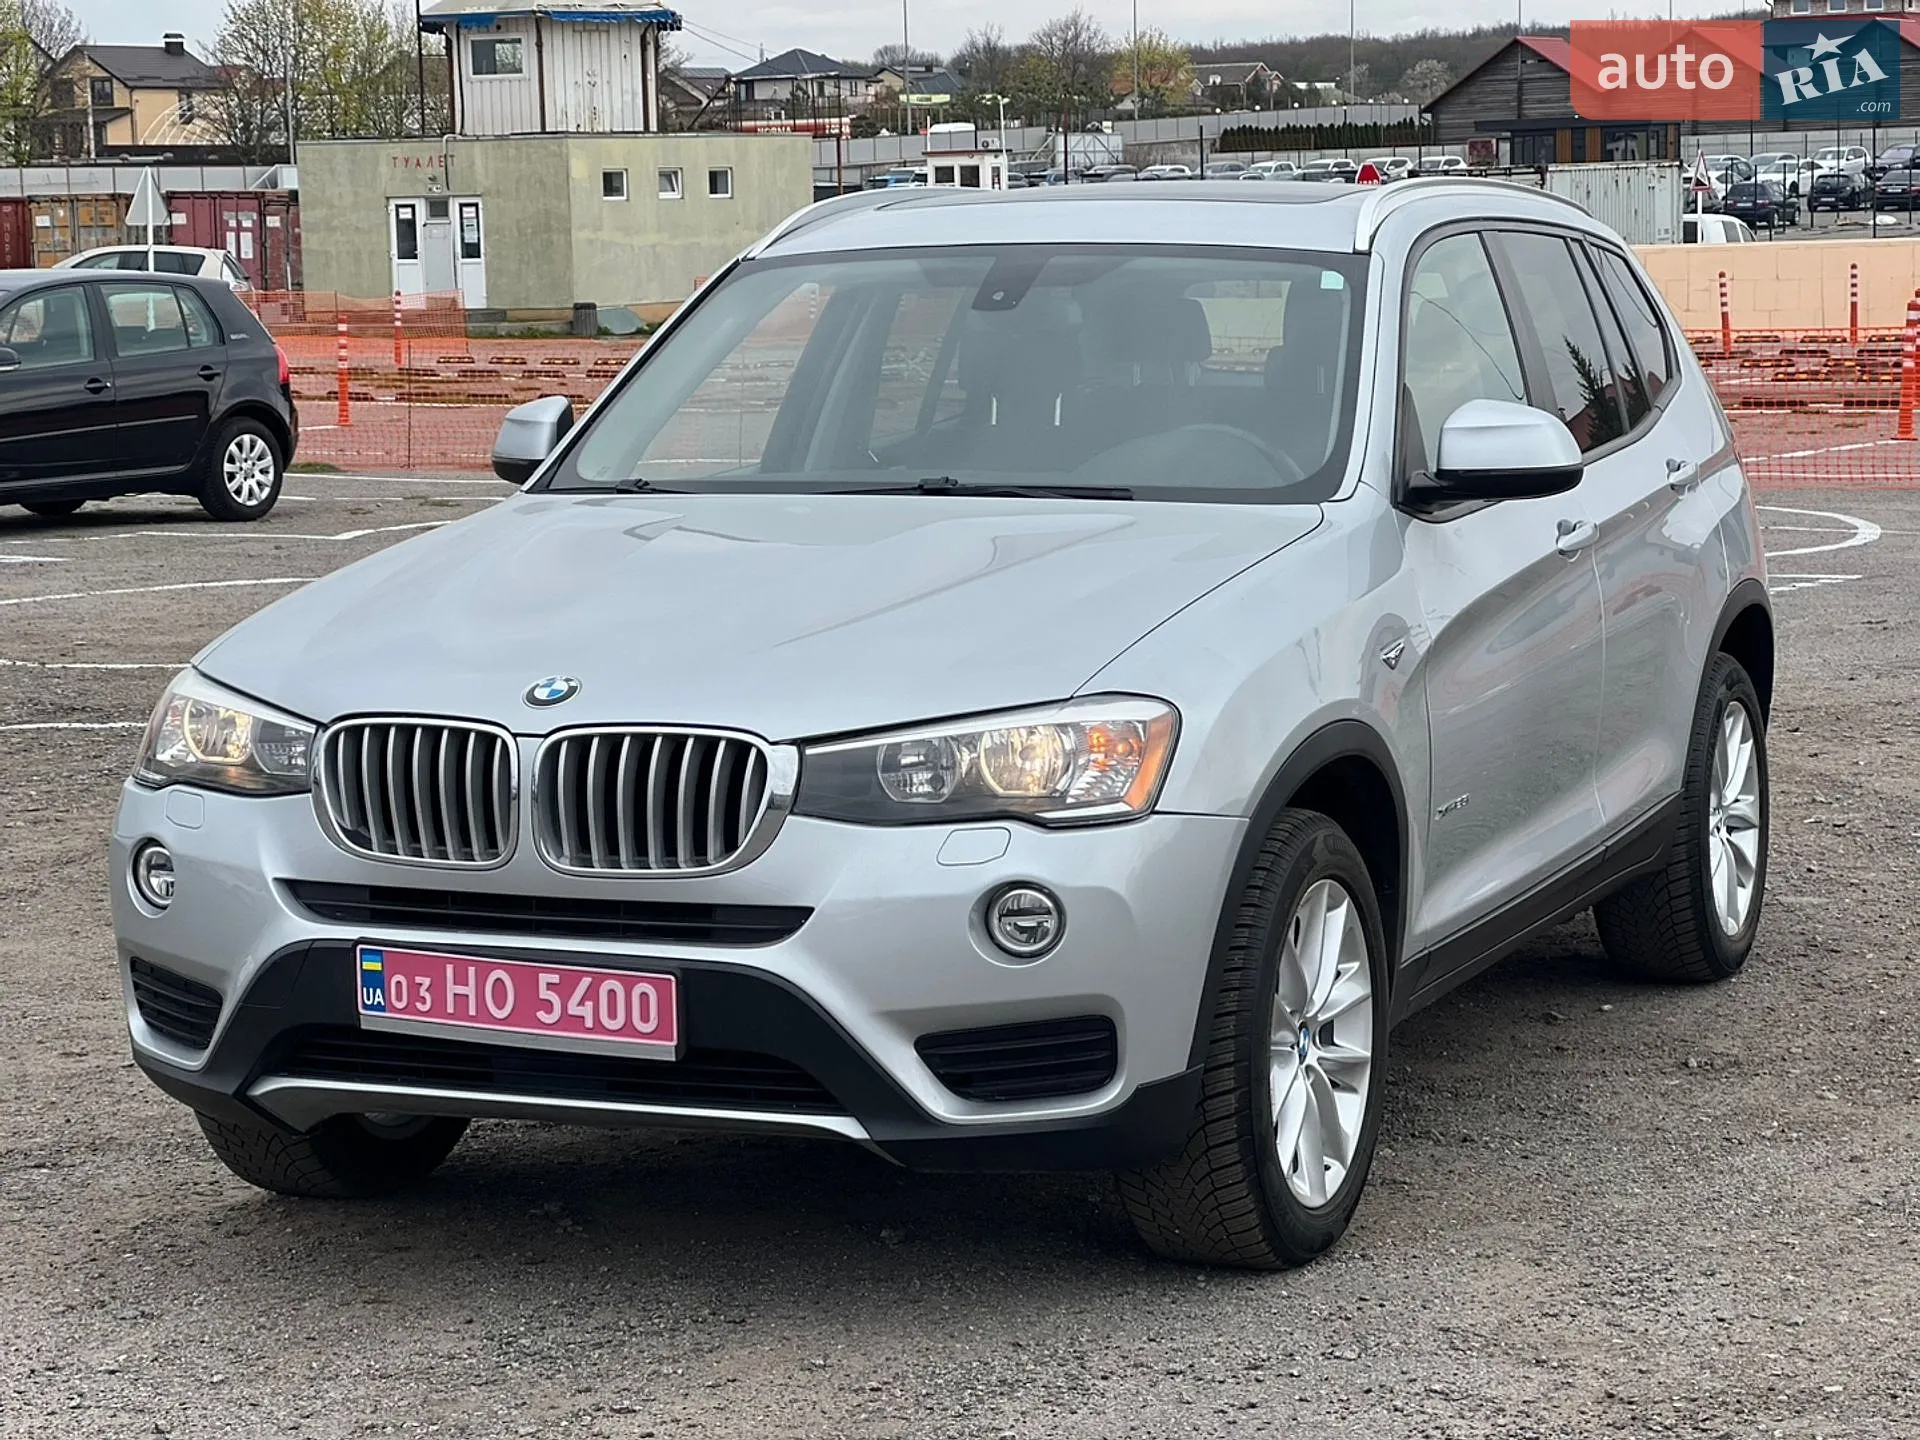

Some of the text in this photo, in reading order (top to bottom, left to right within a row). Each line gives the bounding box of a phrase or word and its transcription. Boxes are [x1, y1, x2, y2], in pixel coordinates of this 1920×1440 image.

[392, 154, 456, 168] ТУАЛЕТ
[363, 987, 385, 1006] UA
[390, 963, 659, 1034] 03 HO 5400
